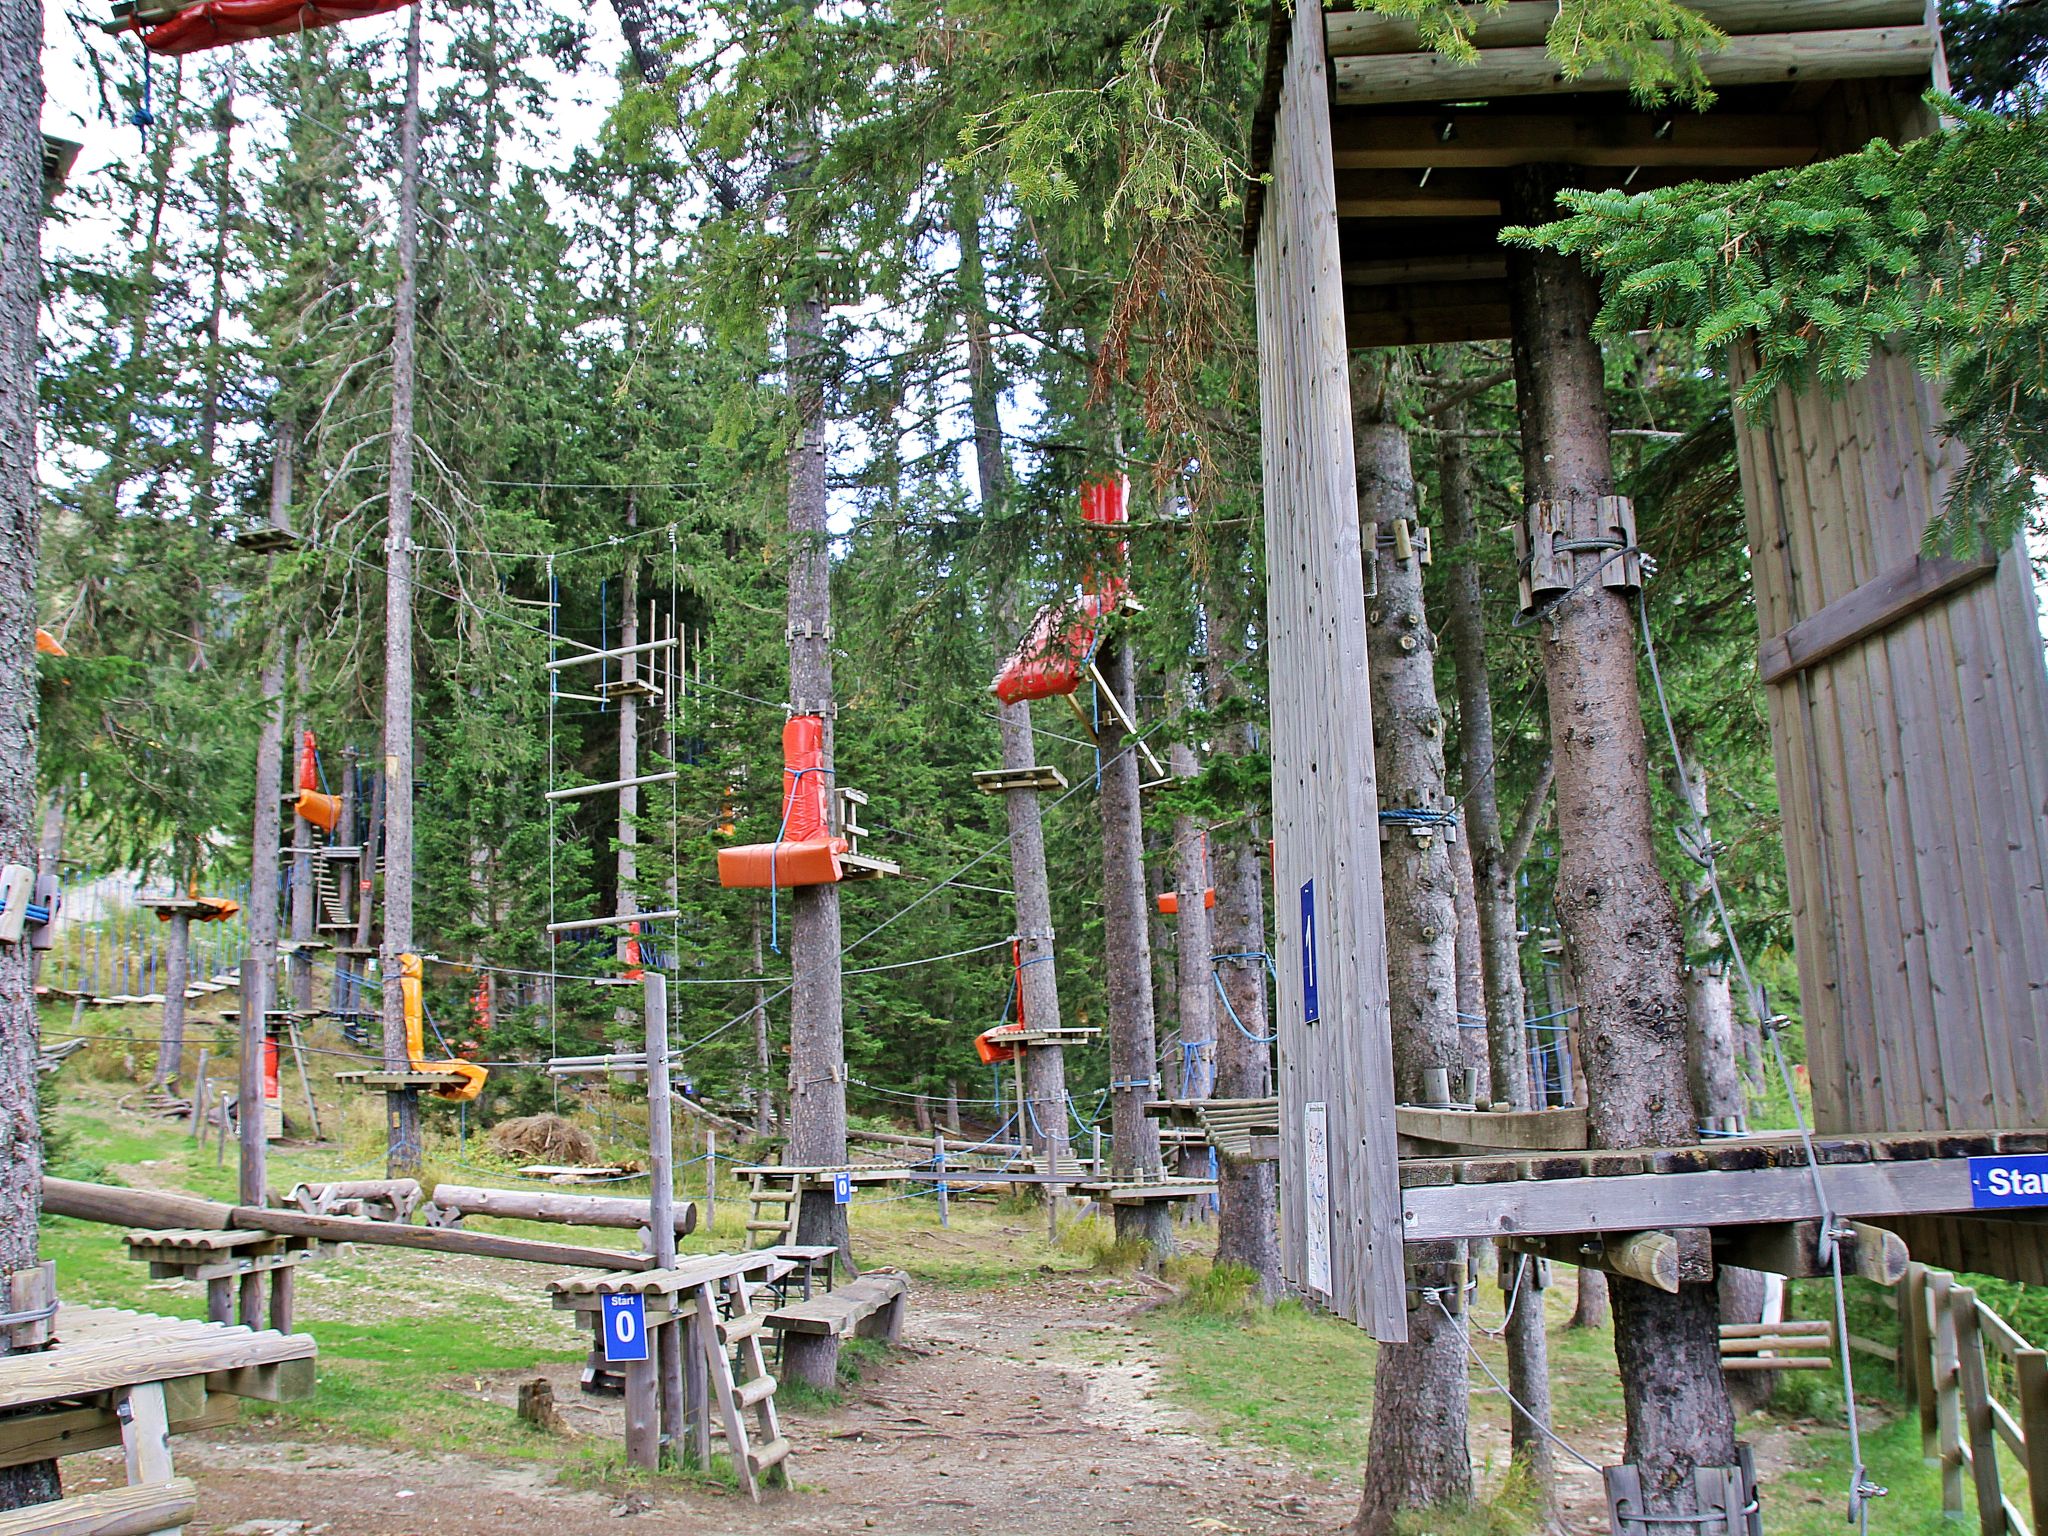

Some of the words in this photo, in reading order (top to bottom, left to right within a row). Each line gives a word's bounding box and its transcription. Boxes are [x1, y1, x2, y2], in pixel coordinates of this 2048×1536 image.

[1305, 914, 1313, 987] 1
[838, 1180, 847, 1195] 0
[611, 1296, 635, 1306] Start
[615, 1310, 636, 1343] 0
